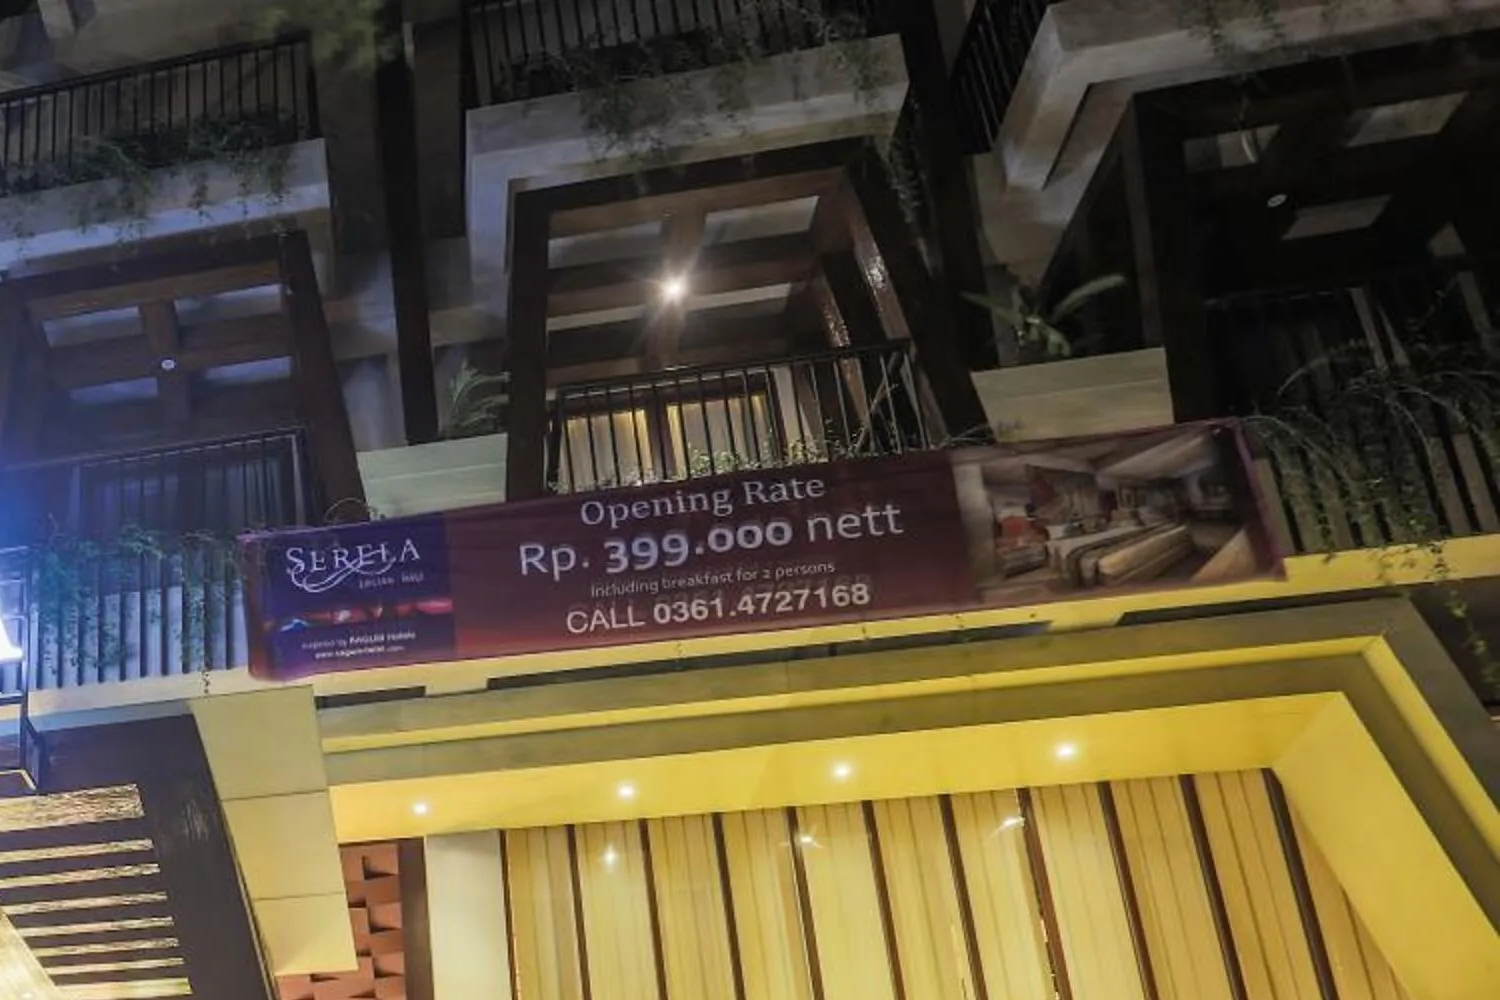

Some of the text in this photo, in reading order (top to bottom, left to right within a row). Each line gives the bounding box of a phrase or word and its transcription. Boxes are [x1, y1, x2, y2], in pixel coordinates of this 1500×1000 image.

[581, 478, 826, 529] Opening Rate
[286, 537, 421, 593] SERELA
[519, 504, 904, 582] Rp. 399.000 nett
[590, 578, 659, 598] Including
[662, 571, 733, 589] breakfast
[737, 567, 758, 581] for
[775, 562, 836, 581] persons
[566, 583, 871, 634] CALL 0361.4727168
